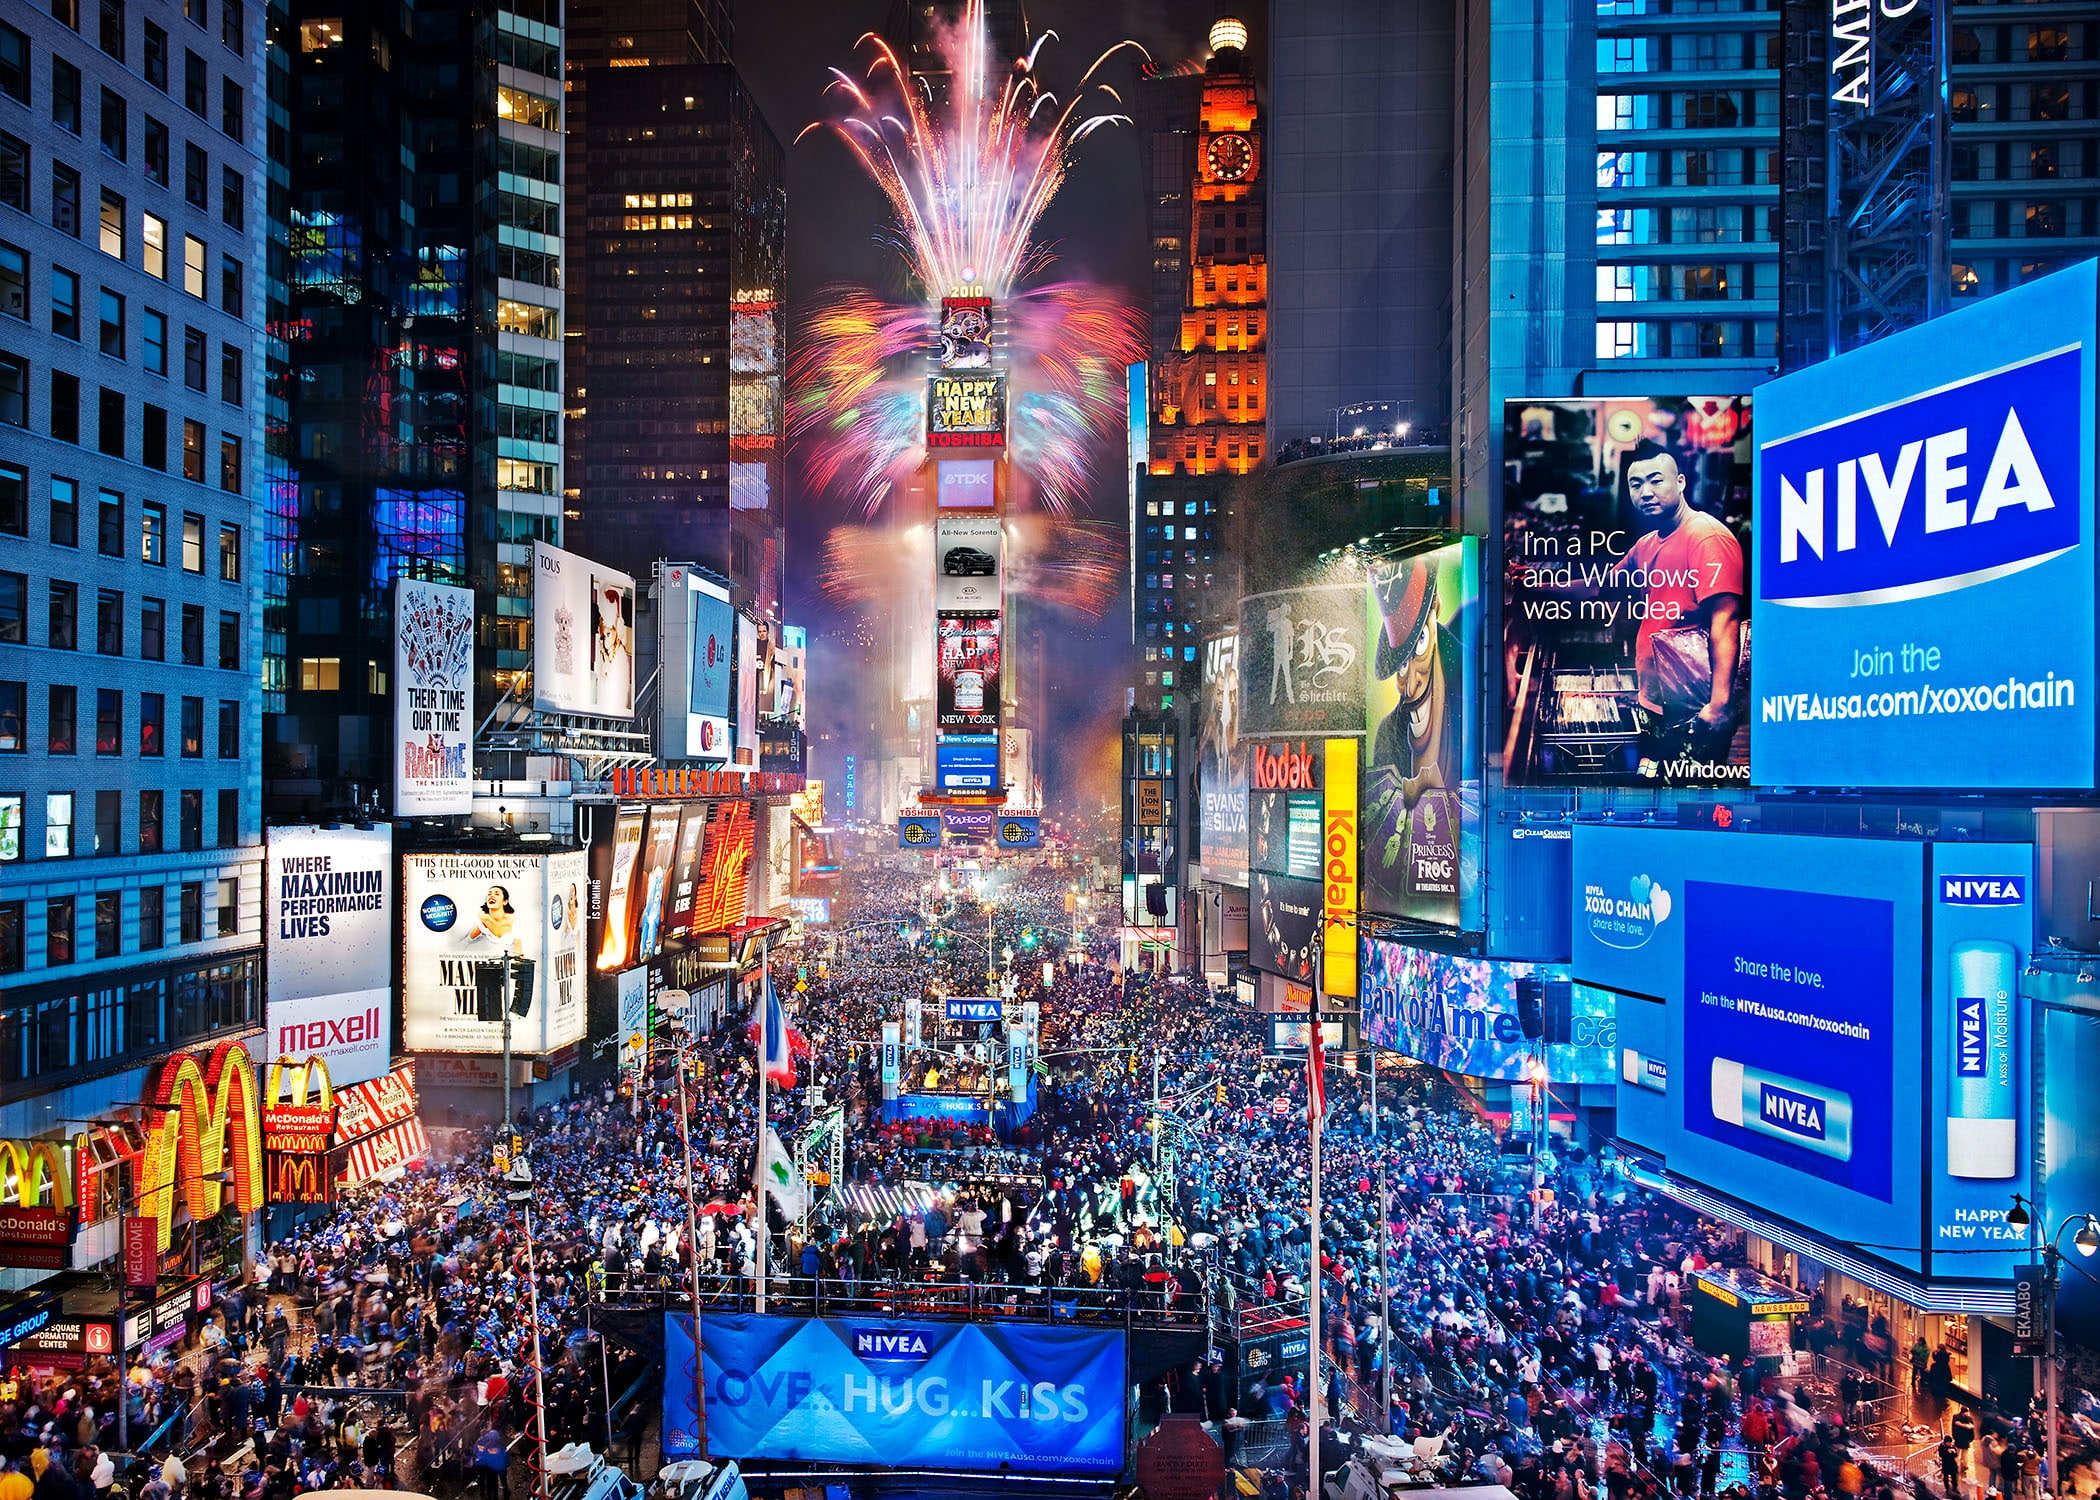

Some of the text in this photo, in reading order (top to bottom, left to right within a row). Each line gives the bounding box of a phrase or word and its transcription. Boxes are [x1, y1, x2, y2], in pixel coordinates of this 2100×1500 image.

[951, 286, 983, 297] 2010
[943, 299, 991, 307] TOSHIBA
[936, 382, 996, 396] HAPPY
[946, 397, 986, 410] NEW
[941, 410, 991, 424] YEAR!
[928, 434, 1004, 446] TOSHIBA
[954, 474, 988, 484] TDK
[1780, 406, 2055, 563] NIVEA
[1566, 537, 1581, 556] a
[1590, 531, 1625, 556] PC
[539, 554, 561, 574] TOUS
[1523, 563, 1722, 589] and Windows 7
[1523, 595, 1685, 627] was my idea.
[717, 644, 724, 662] LG
[942, 648, 995, 660] HAPPY
[1850, 642, 1941, 678] Join the
[407, 688, 465, 710] THEIR TIME
[1300, 690, 1348, 703] Sheckler
[1762, 671, 2074, 723] NIVEAusa.com/xoxochain
[412, 710, 460, 731] OUR TIME
[941, 715, 996, 724] NEW YORK
[405, 741, 467, 778] RAGTIME
[1255, 741, 1315, 789] Kodak
[1663, 758, 1751, 780] Windows
[1141, 796, 1159, 807] LION
[1206, 793, 1244, 812] EVANS
[945, 815, 991, 825] YAHOO!
[1141, 808, 1159, 819] KING
[1214, 813, 1247, 832] SILVA
[628, 826, 640, 842] OPEN
[440, 858, 494, 868] FEEL-GOOD
[498, 858, 541, 868] MUSICAL
[1411, 843, 1455, 865] PRINCESS
[282, 856, 331, 874] WHERE
[427, 869, 436, 879] IS
[440, 869, 446, 879] A
[1327, 810, 1353, 930] Kodak
[1416, 860, 1454, 881] FROG
[281, 870, 382, 899] MAXIMUM
[1585, 885, 1604, 896] NIVEA
[1946, 880, 2021, 899] NIVEA
[281, 893, 382, 917] PERFORMANCE
[592, 880, 601, 920] IS COMING
[1585, 896, 1650, 921] XOXO CHAIN
[280, 915, 331, 940] LIVES
[1593, 918, 1645, 936] share the love.
[555, 952, 576, 981] MAMMA
[1734, 956, 1825, 989] Share the love.
[950, 1003, 998, 1017] NIVEA
[1361, 973, 1408, 1026] Bank
[1430, 993, 1617, 1049] Ameca
[1700, 991, 1870, 1041] Join the NIVEAusa.com/xoxochain
[1994, 990, 2008, 1049] Moisture
[279, 1007, 380, 1054] maxell
[1962, 1002, 1981, 1070] NIVEA
[2000, 1051, 2008, 1063] OF
[1649, 1063, 1666, 1076] NIVEA
[2000, 1079, 2008, 1087] A
[265, 1113, 331, 1124] McDonald's
[1765, 1092, 1821, 1132] NIVEA
[1955, 1208, 2008, 1222] HAPPY
[0, 1218, 66, 1232] cDonald's
[1940, 1226, 2027, 1241] NEW YEAR
[28, 1253, 60, 1263] HOURS
[131, 1221, 143, 1283] WELCOME
[155, 1290, 192, 1316] TIMES SQUARE
[156, 1300, 191, 1325] INFORMATION
[1755, 1303, 1805, 1312] NEWSSTAND
[2017, 1281, 2031, 1337] EKAABO
[14, 1311, 48, 1335] GROUP
[51, 1324, 80, 1333] SQUARE
[164, 1313, 183, 1329] CENTER
[28, 1332, 79, 1341] NFORMATION
[39, 1340, 68, 1349] CENTER
[858, 1334, 927, 1354] NIVEA
[1282, 1343, 1306, 1354] NIVEA
[945, 1449, 1115, 1466] Join the NIVEAusa.com/xoxochain
